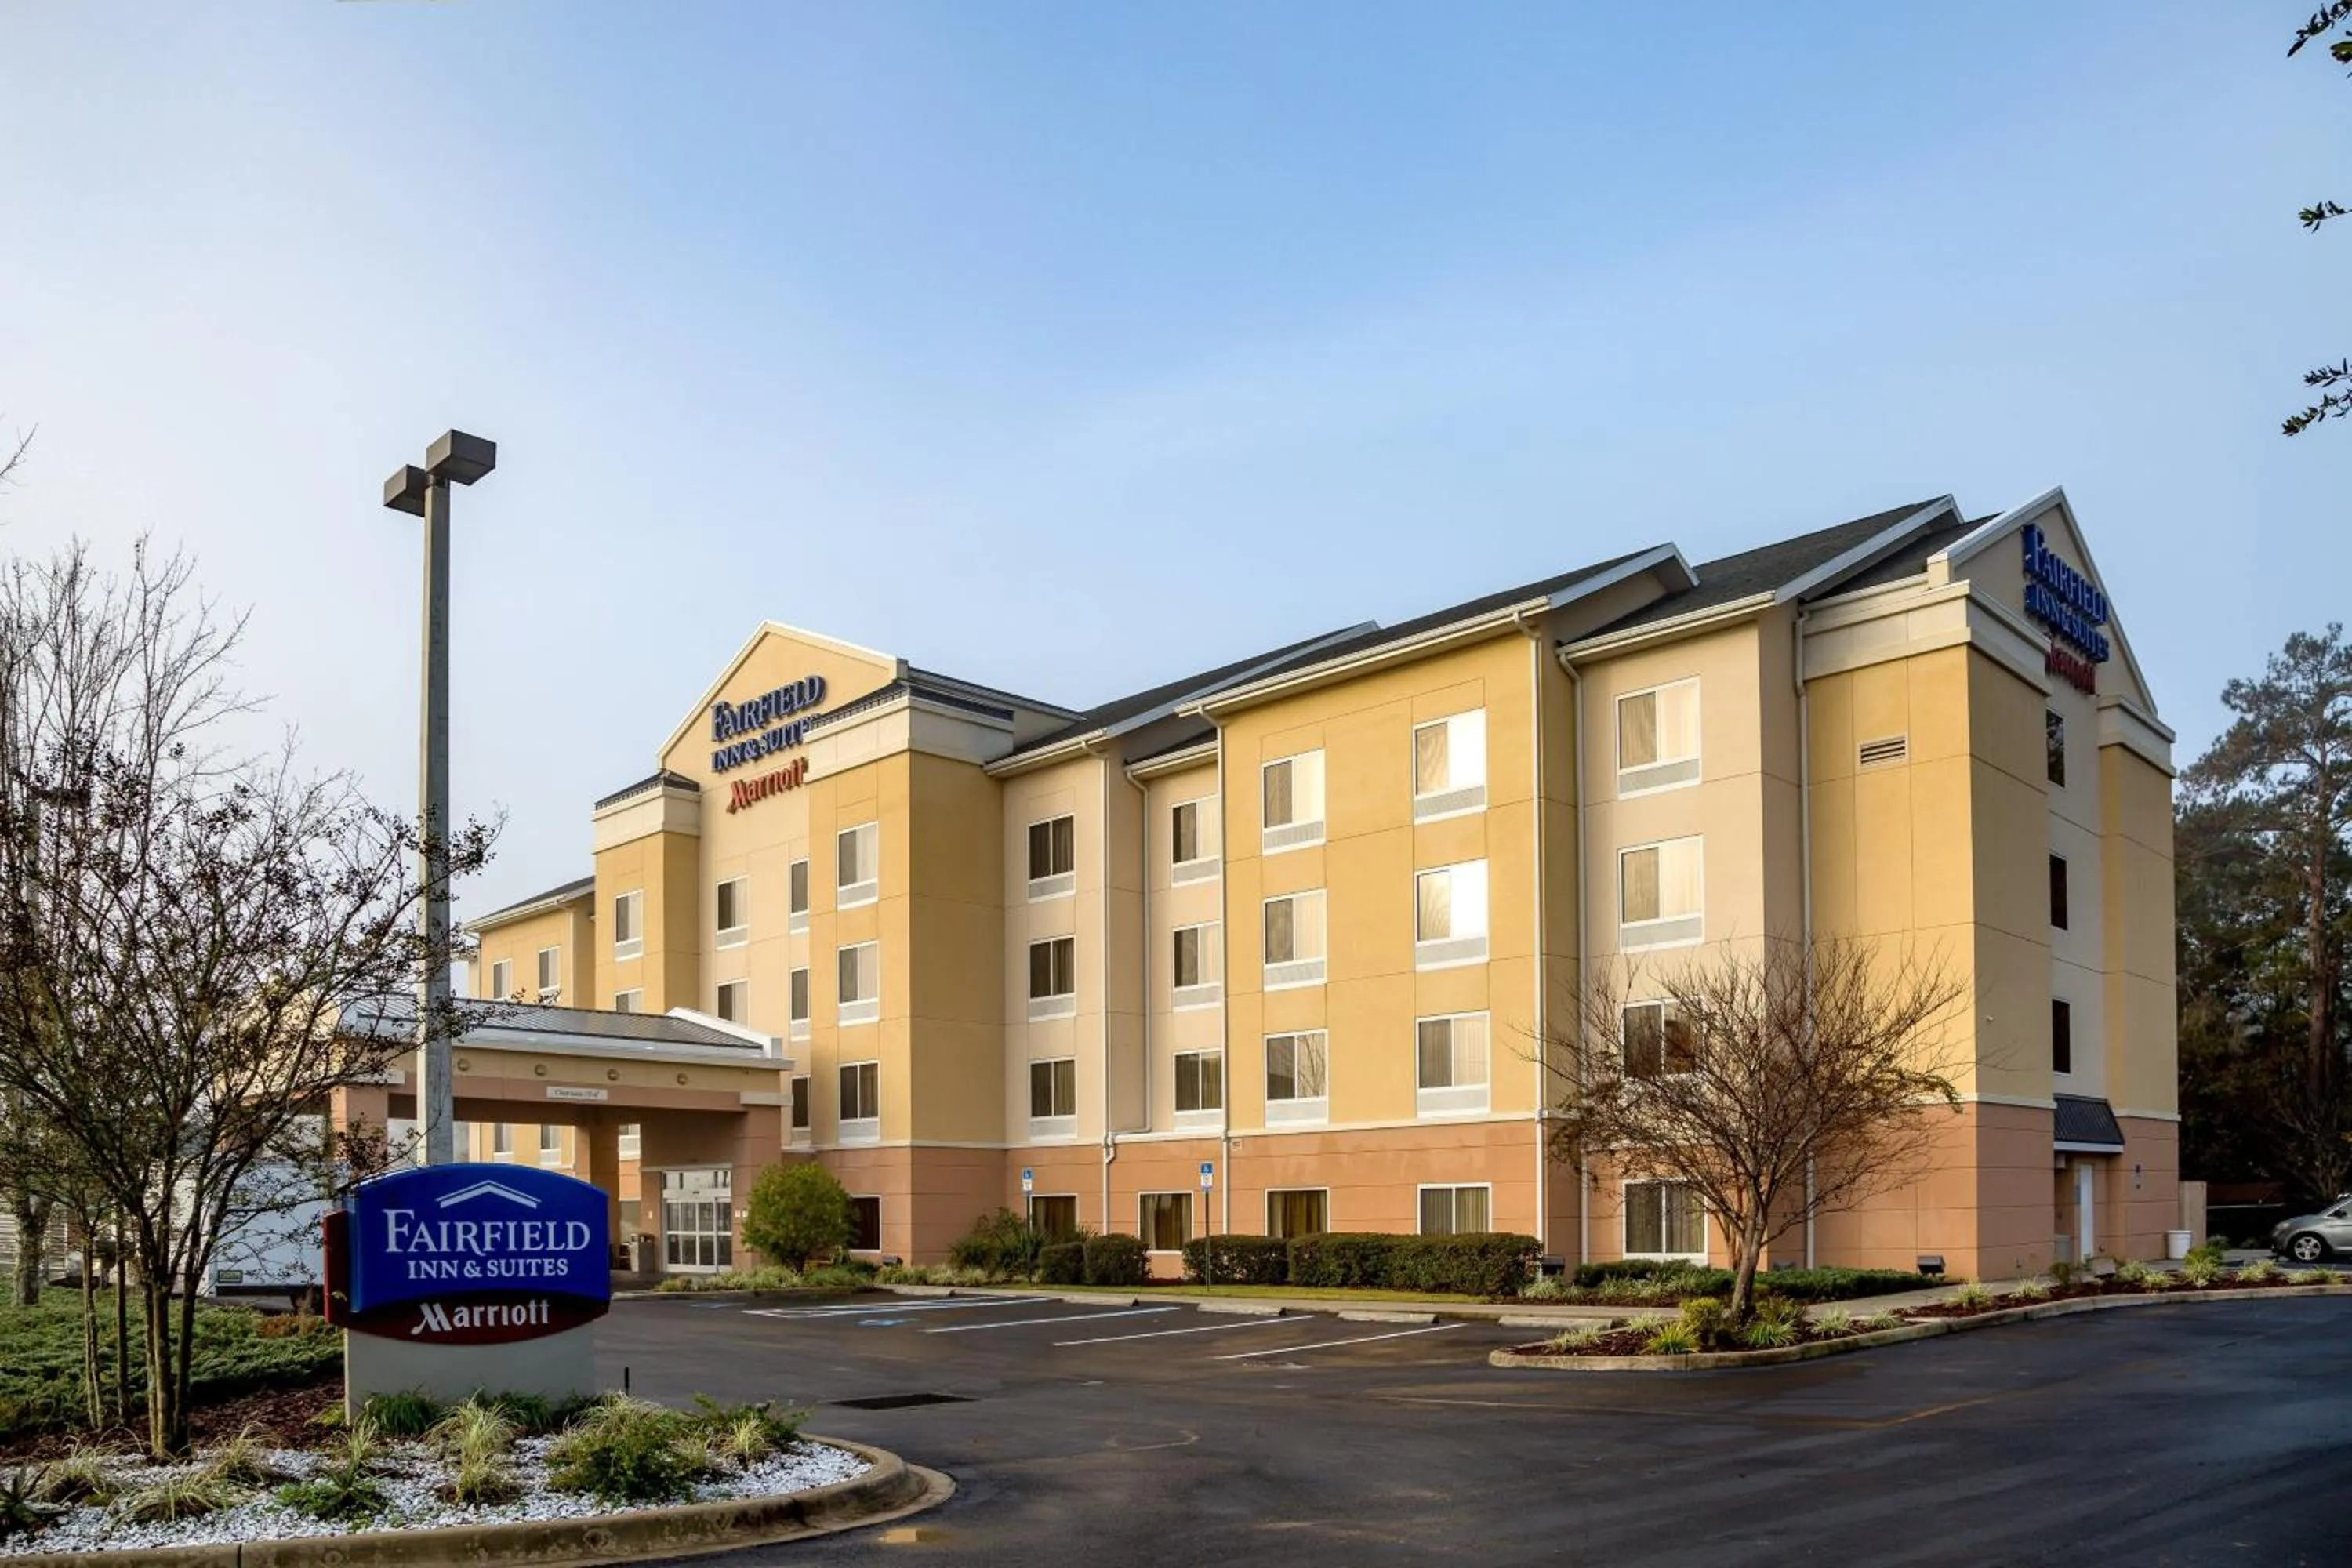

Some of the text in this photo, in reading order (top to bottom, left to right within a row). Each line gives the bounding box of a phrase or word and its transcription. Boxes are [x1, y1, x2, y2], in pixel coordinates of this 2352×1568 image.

[711, 675, 826, 742] FAIRFIELD
[711, 745, 742, 772] INN
[759, 717, 813, 753] SUITE
[727, 757, 808, 814] Marriott
[383, 1209, 590, 1256] FAIRFIELD
[408, 1258, 569, 1279] INN & SUITES
[411, 1299, 550, 1335] Marriott
